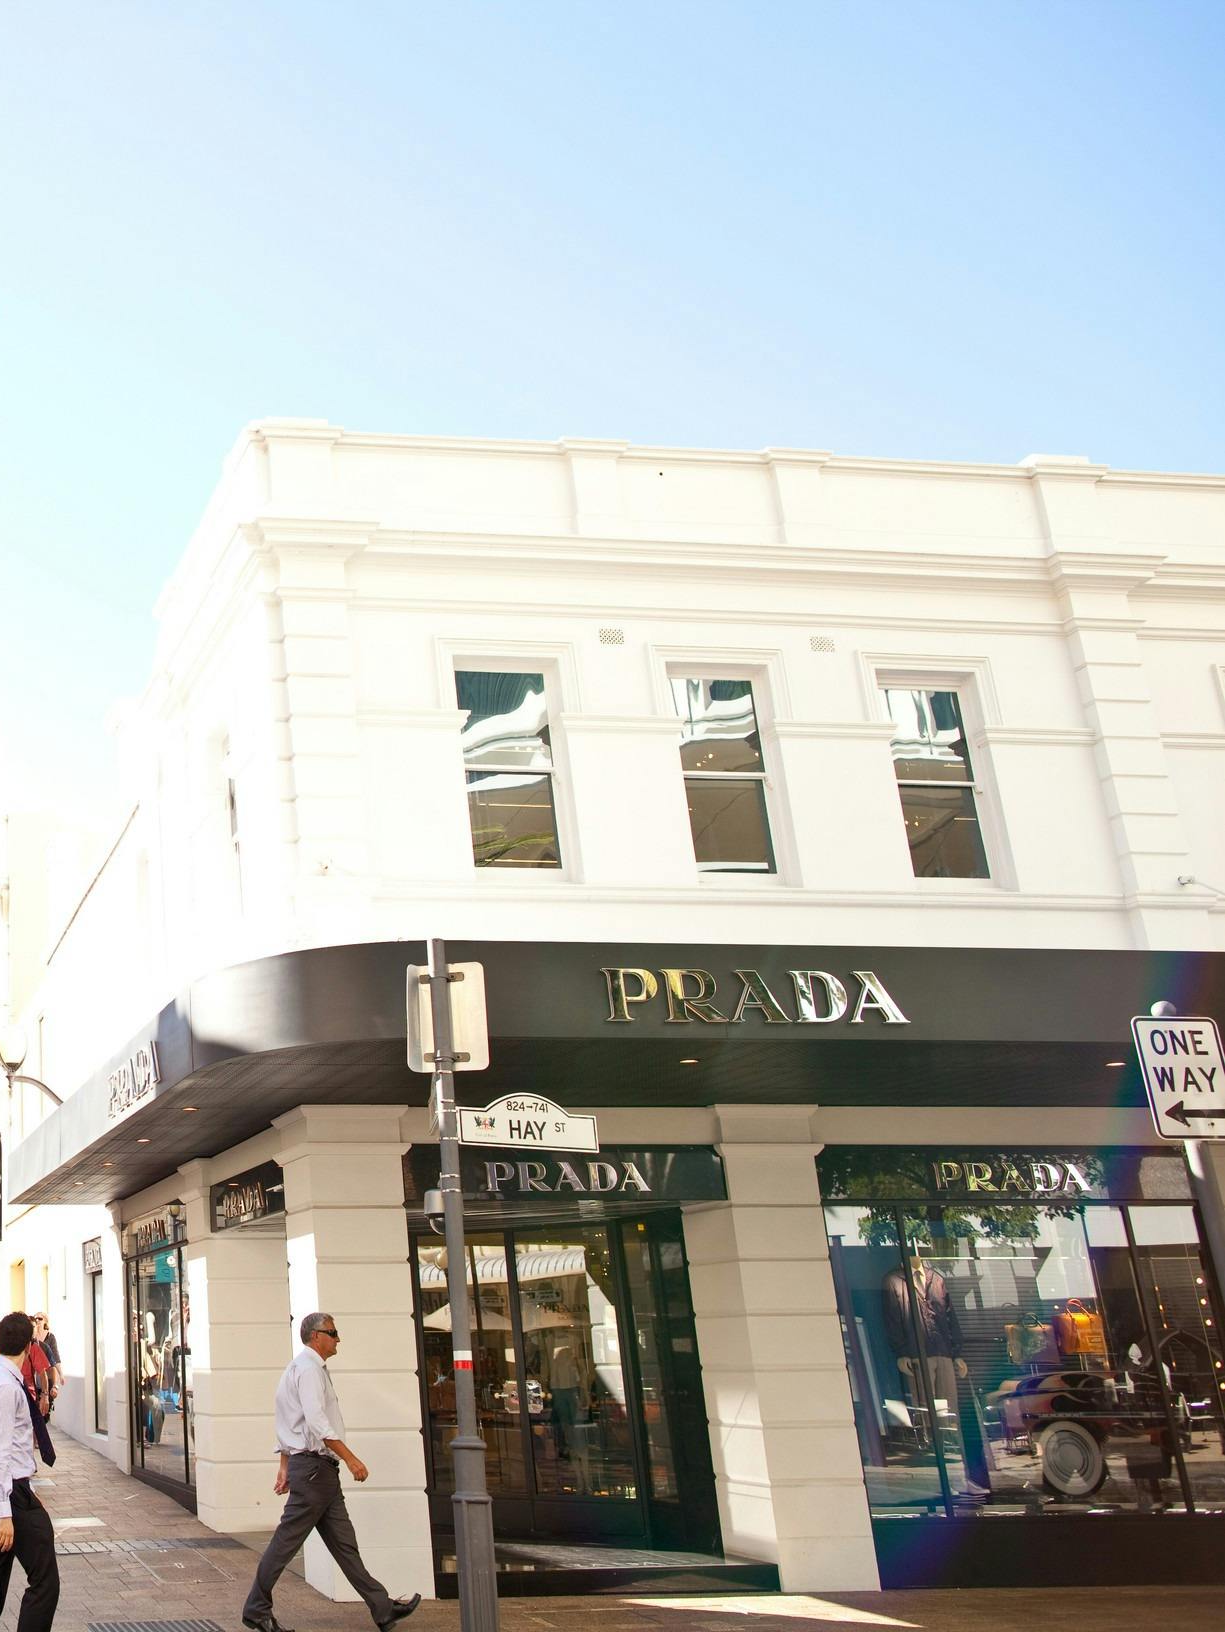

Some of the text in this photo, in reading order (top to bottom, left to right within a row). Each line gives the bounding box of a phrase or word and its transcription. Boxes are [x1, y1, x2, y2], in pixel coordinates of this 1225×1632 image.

[601, 967, 911, 1025] PRADA
[1149, 1029, 1209, 1056] ONE
[107, 1040, 161, 1118] PRADA
[1153, 1066, 1218, 1093] WAY
[506, 1100, 549, 1113] 824-741
[509, 1119, 566, 1141] HAY ST
[484, 1161, 652, 1192] PRADA
[931, 1161, 1092, 1192] PRADA
[223, 1182, 266, 1219] PRADA
